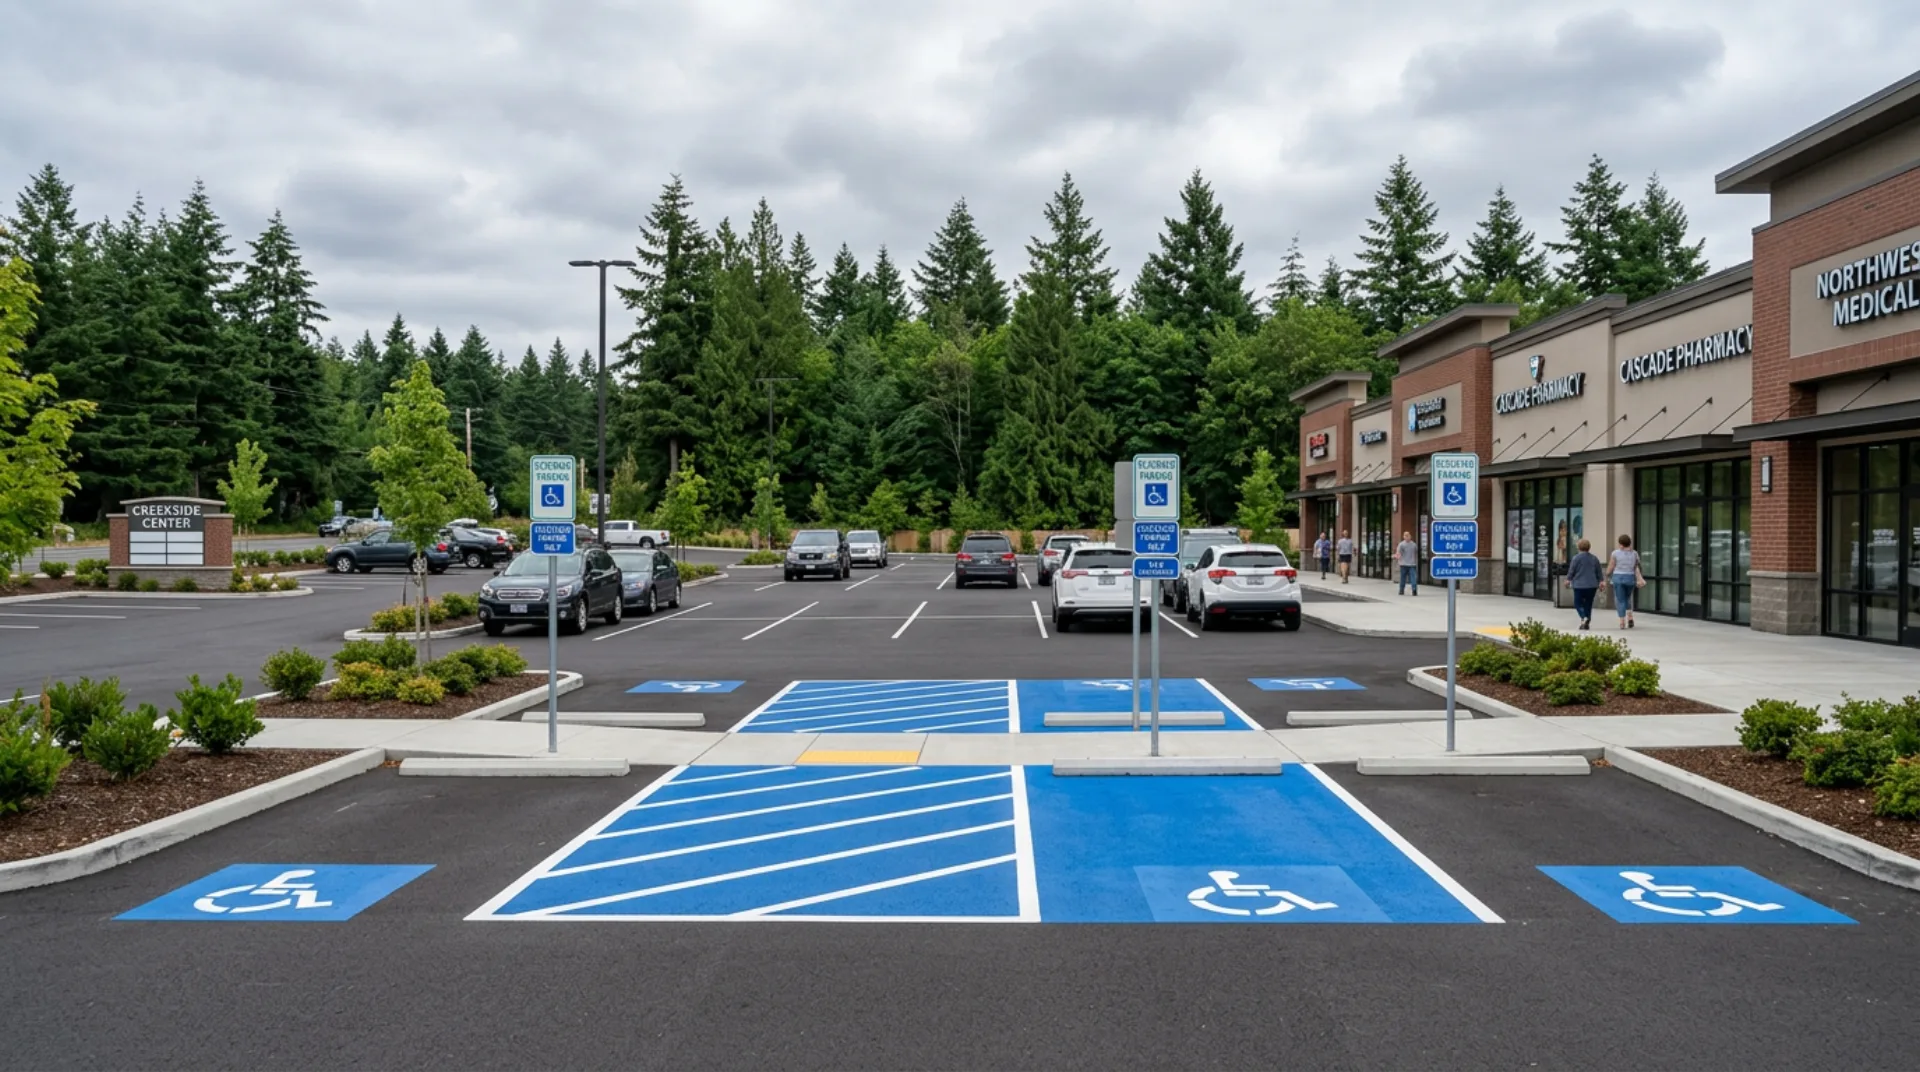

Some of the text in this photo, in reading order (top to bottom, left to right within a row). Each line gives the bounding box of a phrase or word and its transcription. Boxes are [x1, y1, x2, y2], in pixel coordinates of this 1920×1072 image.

[1833, 279, 1920, 327] MEDICAL
[1619, 325, 1752, 384] CASCADE PHARMACY
[142, 517, 191, 529] CENTER
